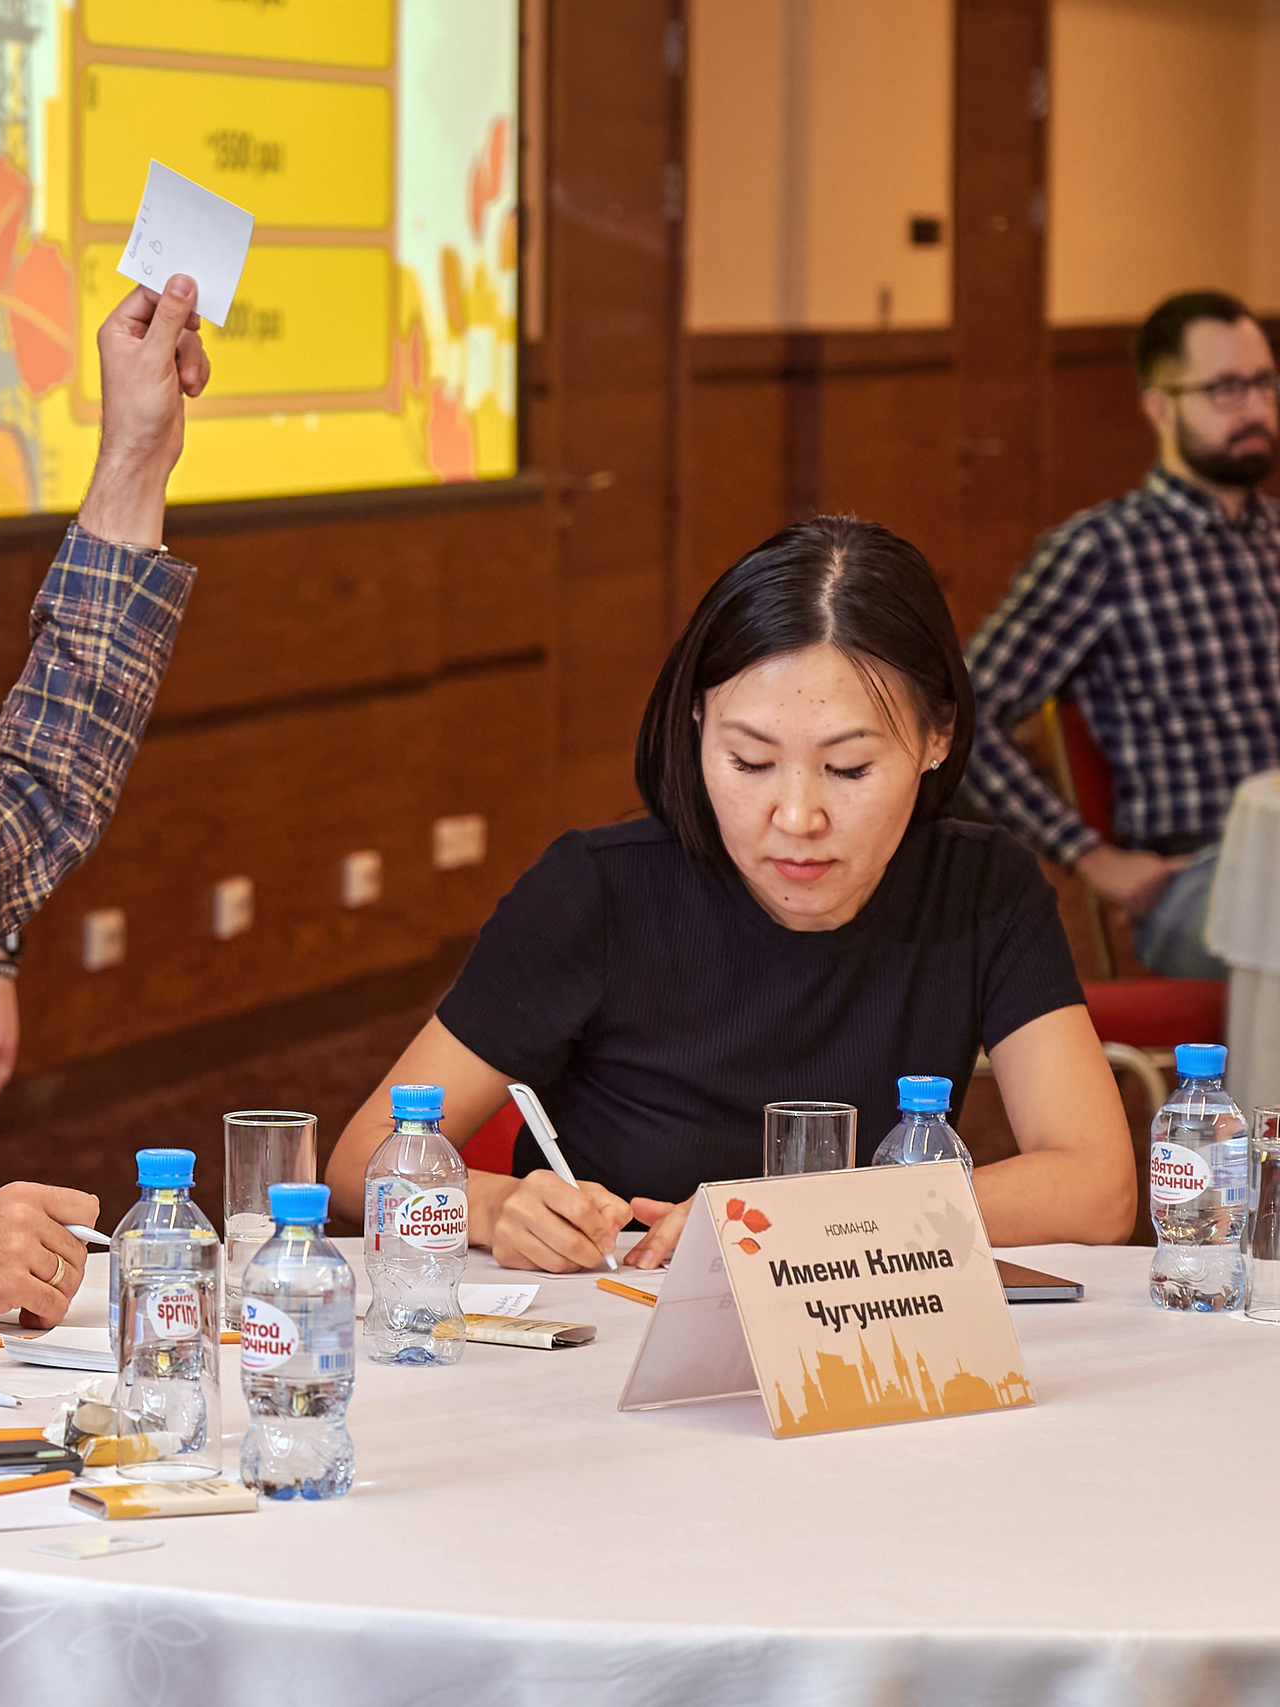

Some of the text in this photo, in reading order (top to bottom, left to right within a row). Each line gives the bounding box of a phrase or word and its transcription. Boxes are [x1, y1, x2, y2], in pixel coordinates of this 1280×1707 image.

[410, 1205, 464, 1222] святой
[824, 1220, 880, 1237] КОМАНДА
[769, 1248, 954, 1287] Имени Клима
[805, 1293, 944, 1333] Чугункина
